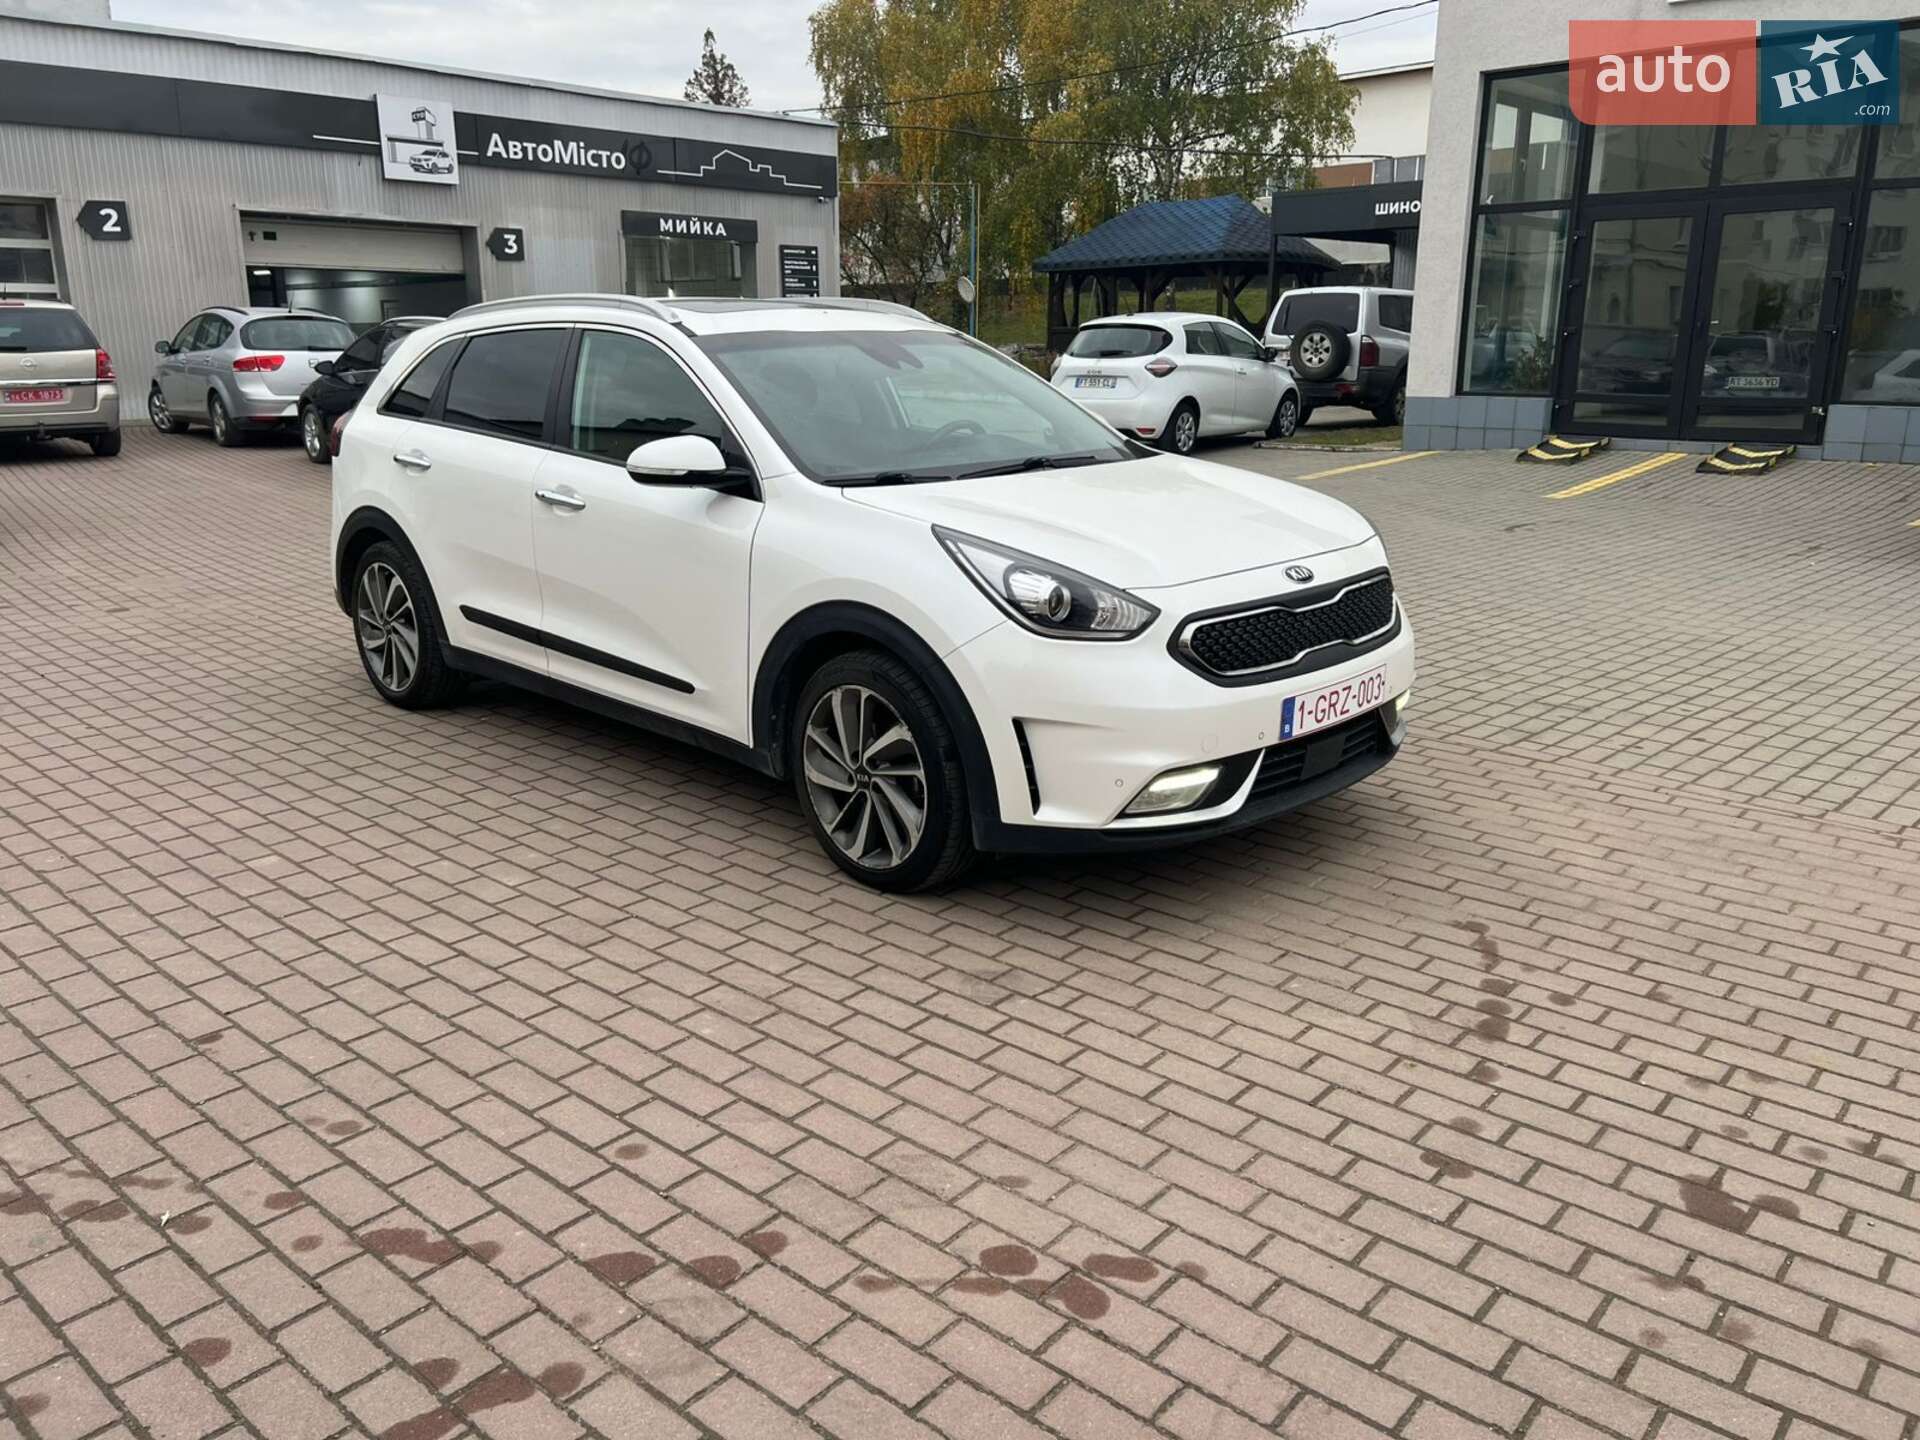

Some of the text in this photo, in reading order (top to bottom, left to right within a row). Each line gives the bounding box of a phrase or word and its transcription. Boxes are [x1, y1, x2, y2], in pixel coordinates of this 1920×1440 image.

[486, 132, 626, 170] АвтоМісто
[1375, 200, 1421, 215] ШИНО
[99, 208, 122, 232] 2
[659, 217, 727, 237] МИЙКА
[503, 234, 518, 254] 3
[1286, 567, 1312, 580] KIA
[1297, 673, 1382, 729] 1-GRZ-003
[1284, 724, 1290, 733] B
